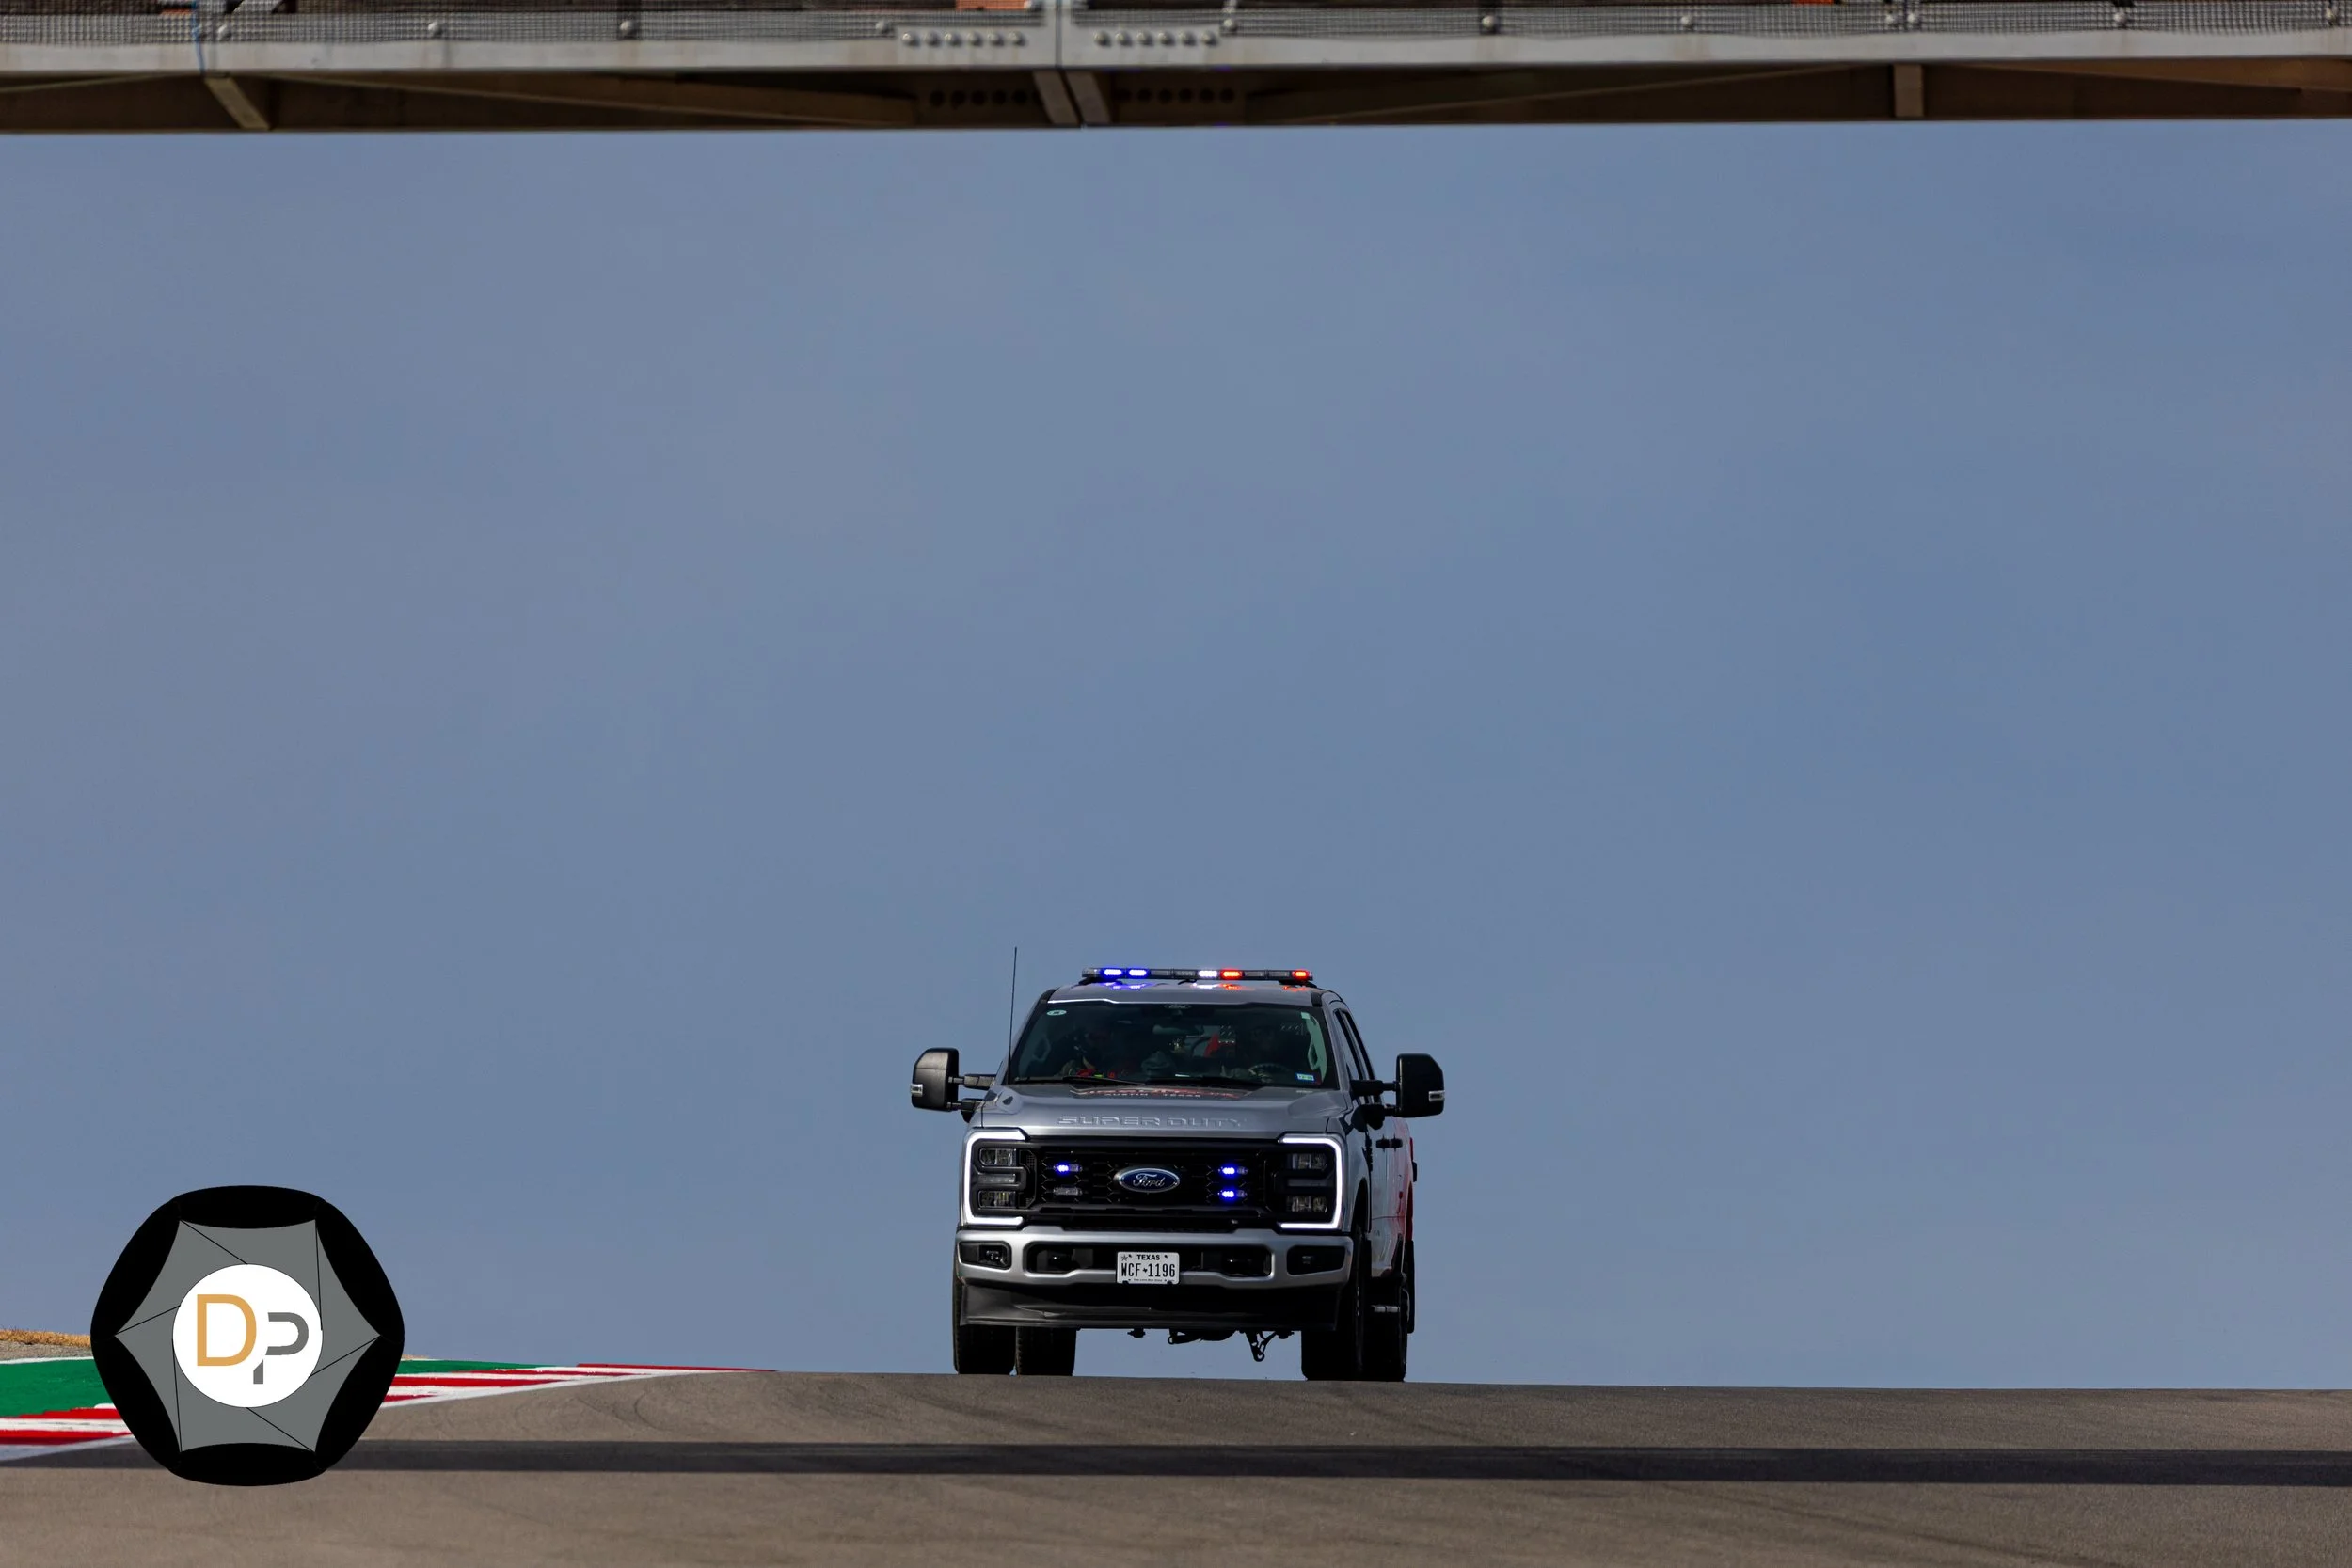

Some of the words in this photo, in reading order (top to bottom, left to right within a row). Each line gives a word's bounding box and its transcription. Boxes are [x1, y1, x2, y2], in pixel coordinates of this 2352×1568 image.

[1057, 1115, 1161, 1127] SUPER
[1167, 1116, 1247, 1128] DUTY
[1133, 1172, 1166, 1187] Ford
